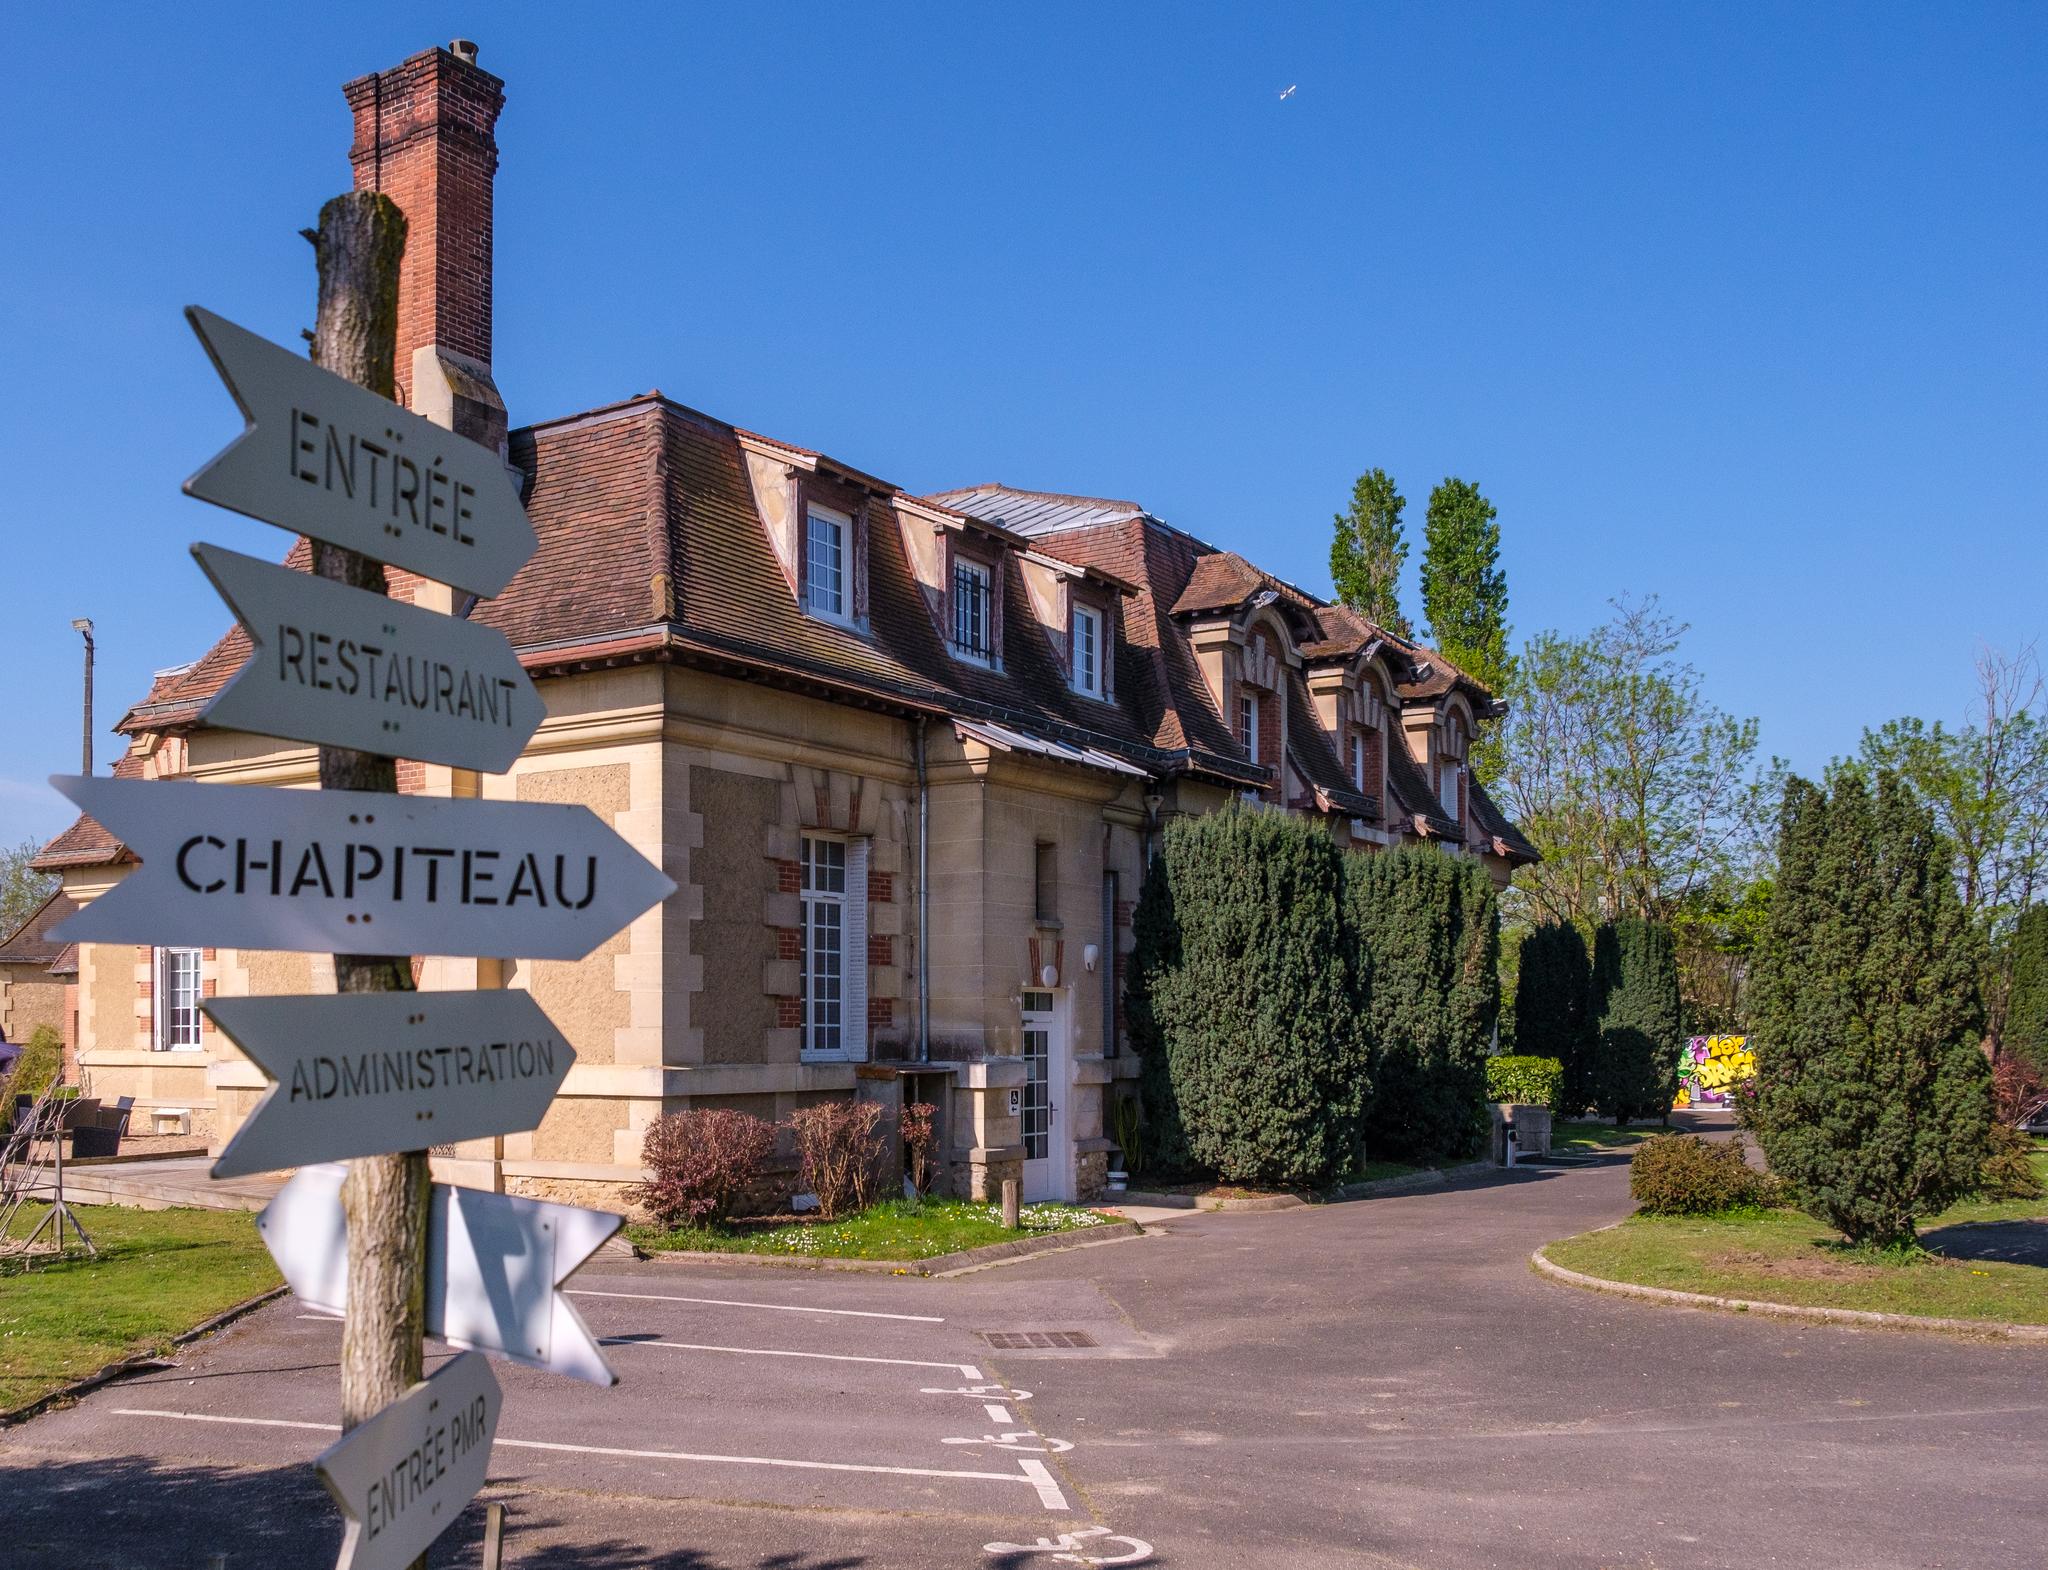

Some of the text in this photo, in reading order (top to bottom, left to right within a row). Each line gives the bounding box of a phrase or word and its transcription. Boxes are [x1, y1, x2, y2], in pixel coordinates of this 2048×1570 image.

[290, 407, 475, 547] ENTRÉE
[278, 624, 517, 728] RESTAURANT
[175, 834, 597, 910] CHAPITEAU
[289, 1040, 554, 1103] ADMINISTRATION
[367, 1394, 487, 1541] ENTRÉE PMR
